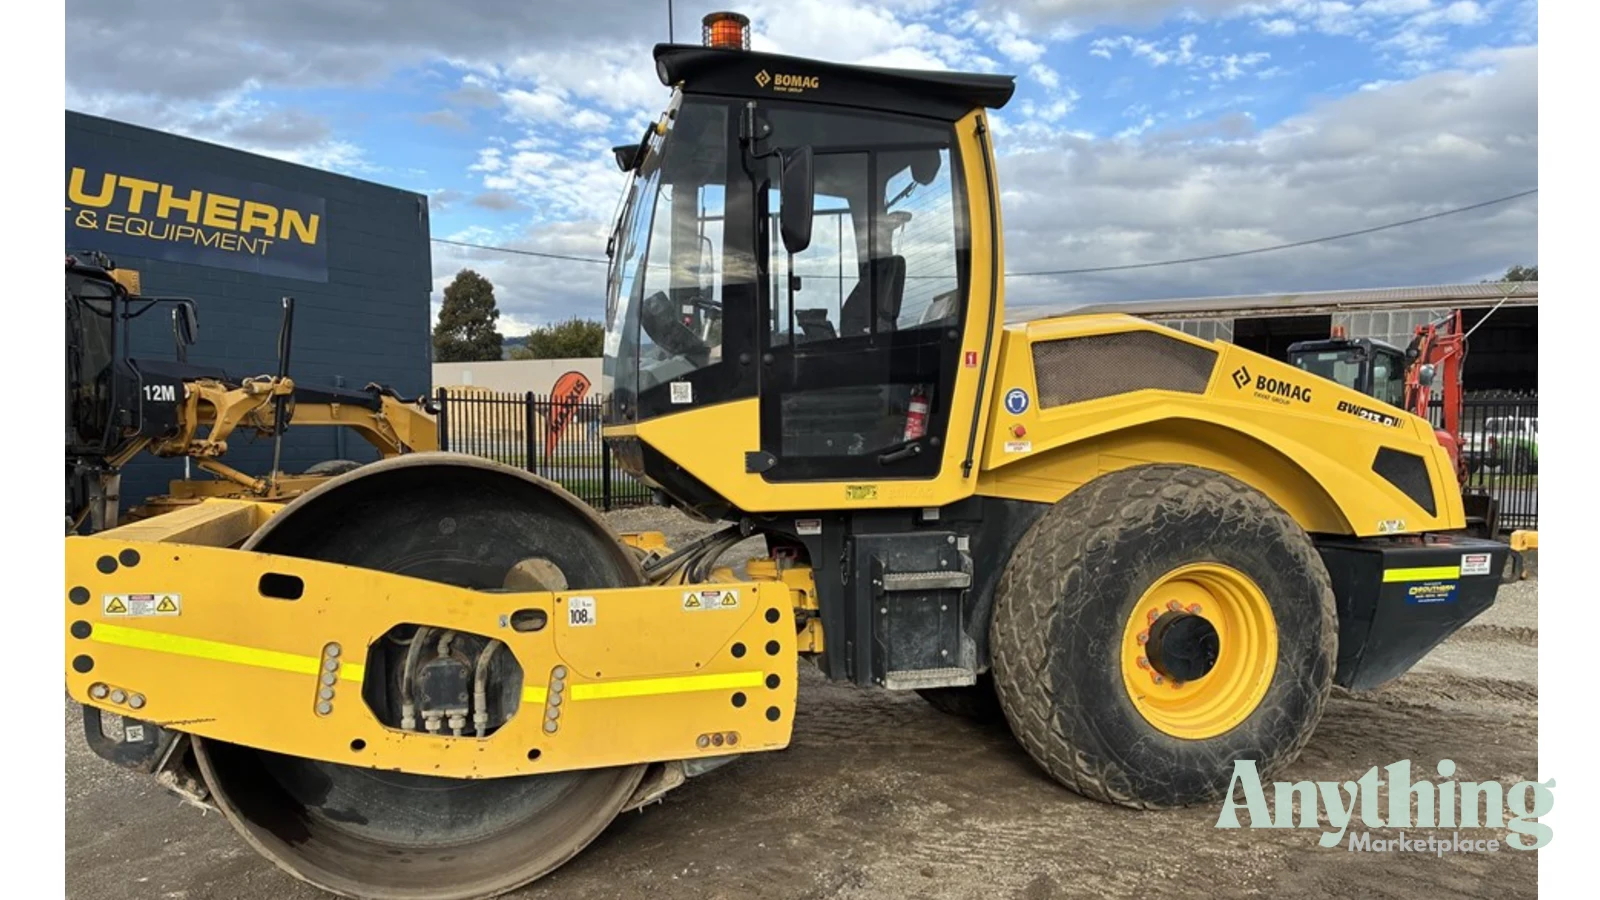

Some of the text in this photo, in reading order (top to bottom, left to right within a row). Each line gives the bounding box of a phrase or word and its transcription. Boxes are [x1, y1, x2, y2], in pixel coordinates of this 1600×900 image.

[774, 74, 819, 88] BOMAG
[68, 167, 320, 245] UTHERN
[75, 210, 274, 255] & EQUIPMENT
[143, 384, 176, 402] 12M
[1256, 375, 1312, 403] BOMAG
[570, 608, 588, 624] 108
